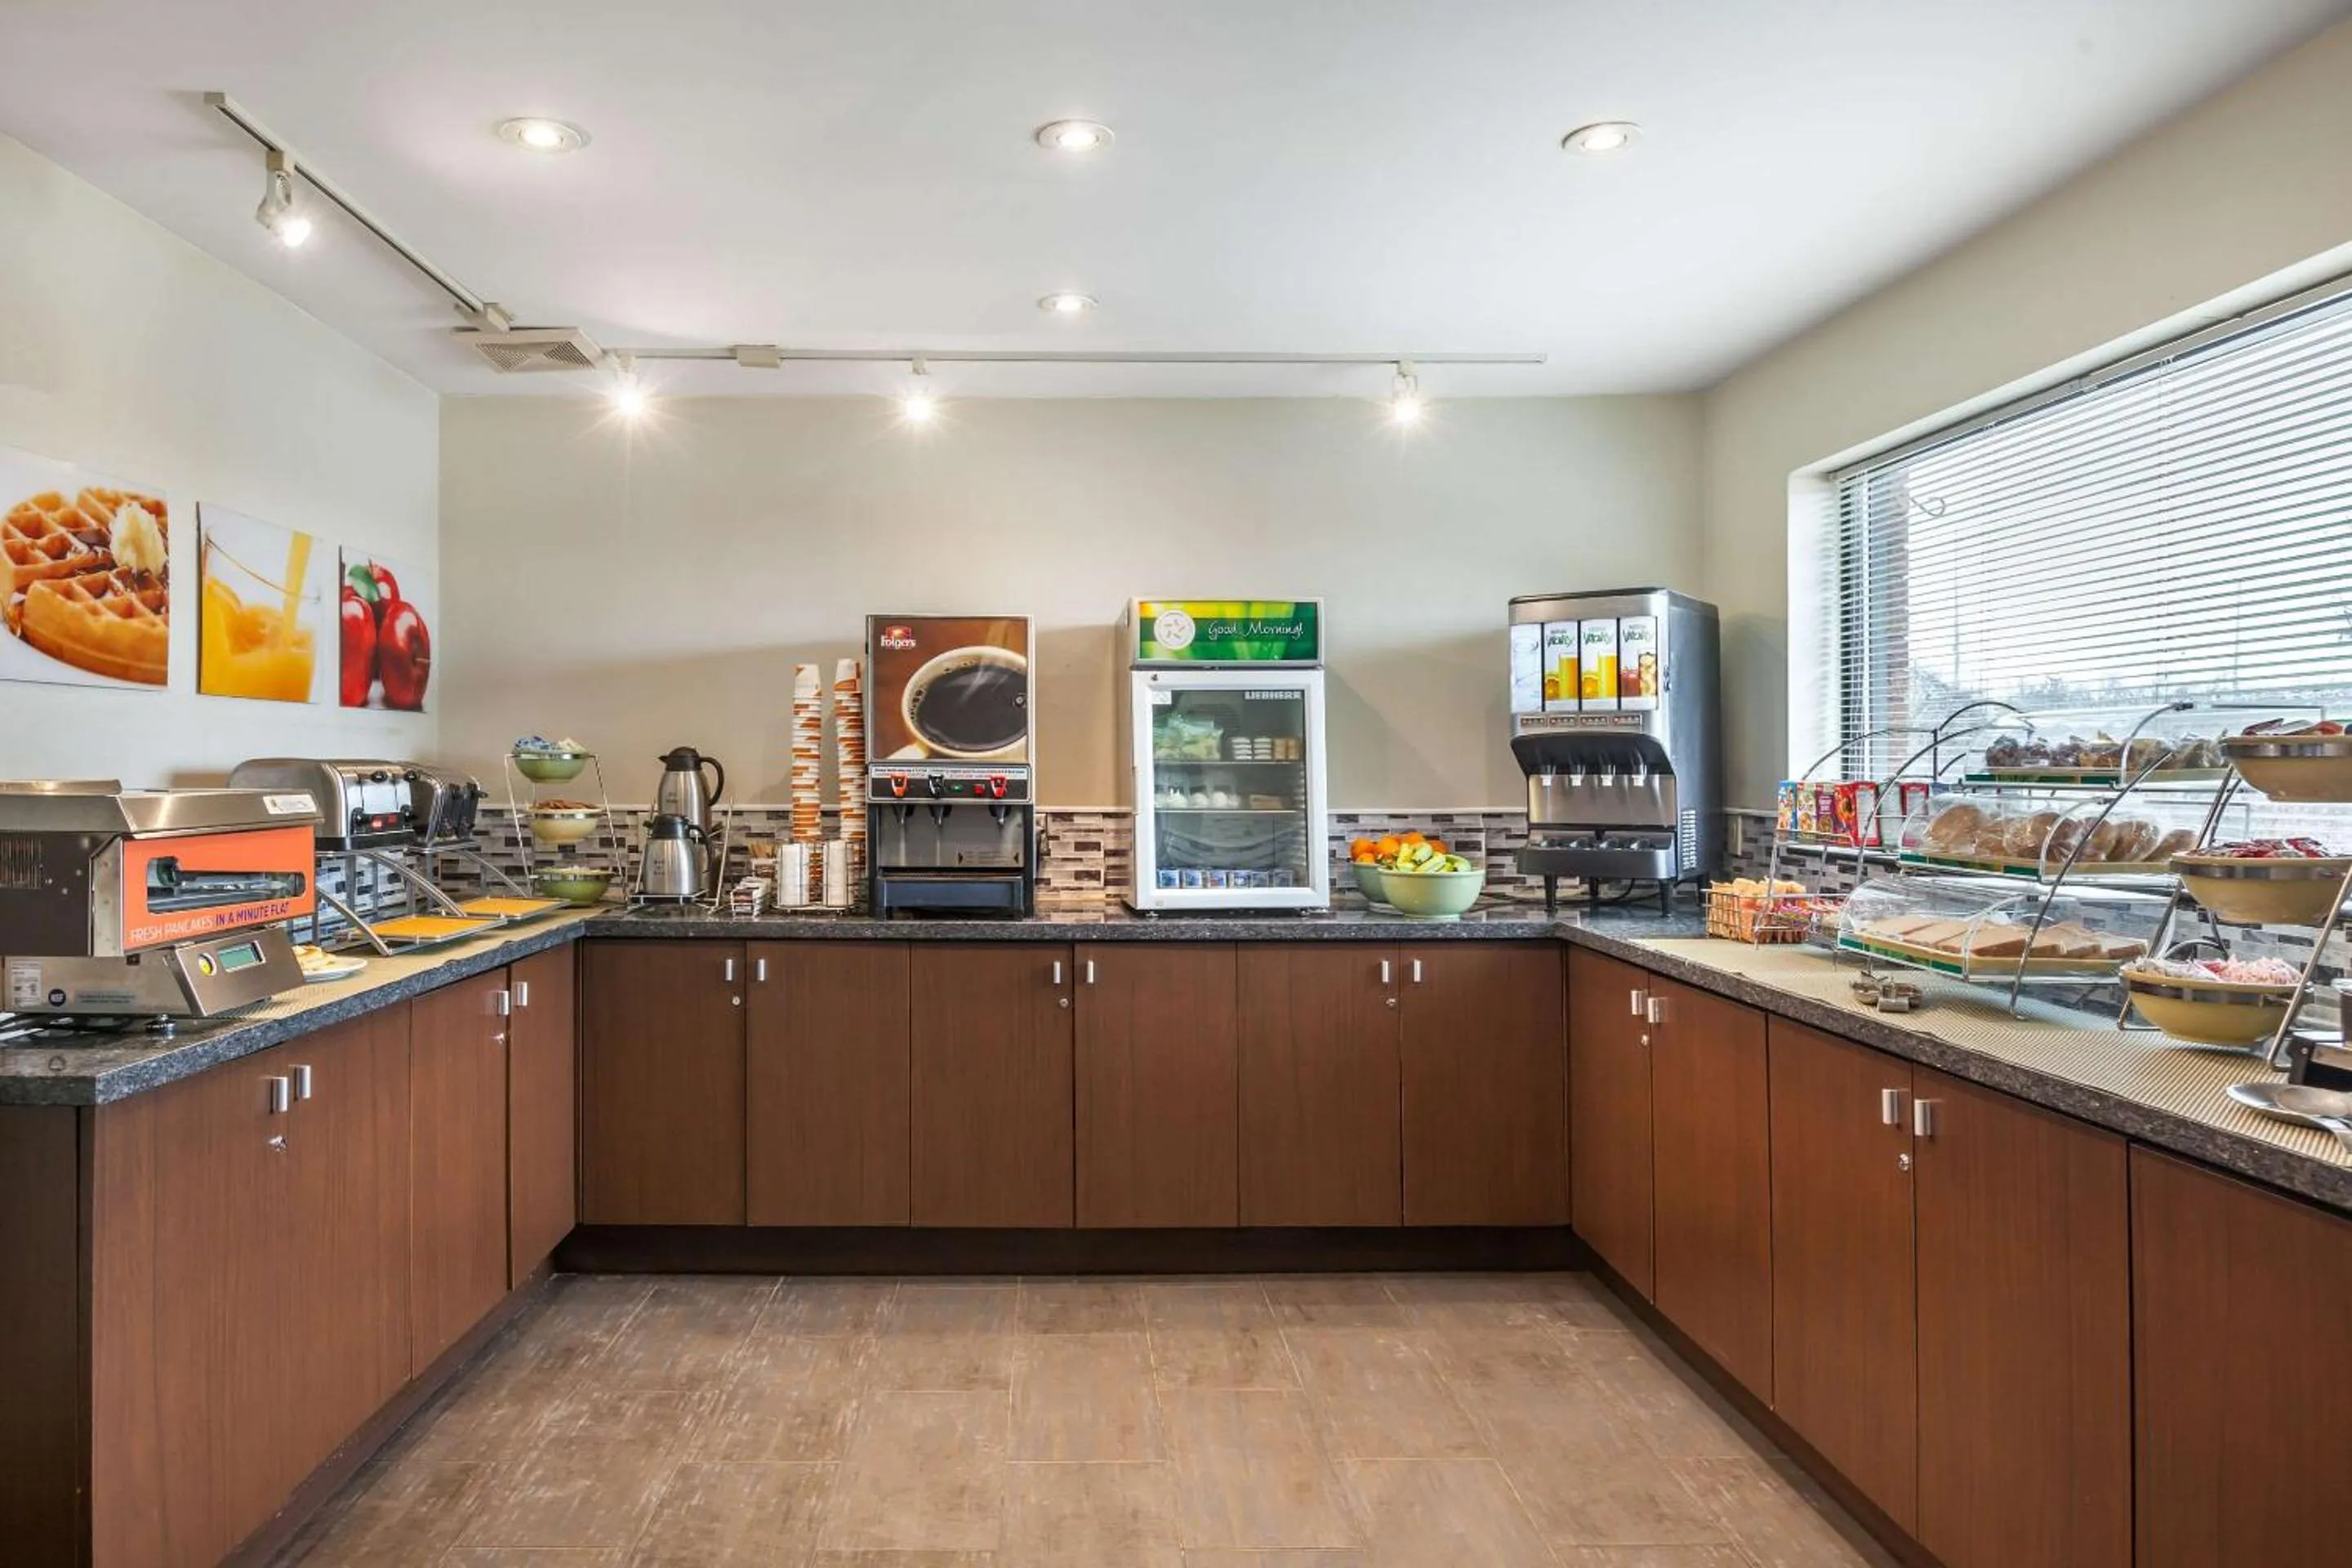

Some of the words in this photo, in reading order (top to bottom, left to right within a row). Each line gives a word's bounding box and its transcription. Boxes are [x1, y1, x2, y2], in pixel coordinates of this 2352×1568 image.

[1207, 621, 1237, 640] Good
[1241, 621, 1304, 640] Morning!
[880, 635, 915, 650] Folgers
[1244, 691, 1303, 700] LIEBHERR
[130, 925, 163, 942] FRESH
[165, 915, 212, 934] PANCAKES
[216, 914, 225, 925] IN
[227, 912, 234, 924] A
[236, 906, 270, 923] MINUTE
[271, 902, 290, 916] FLAT
